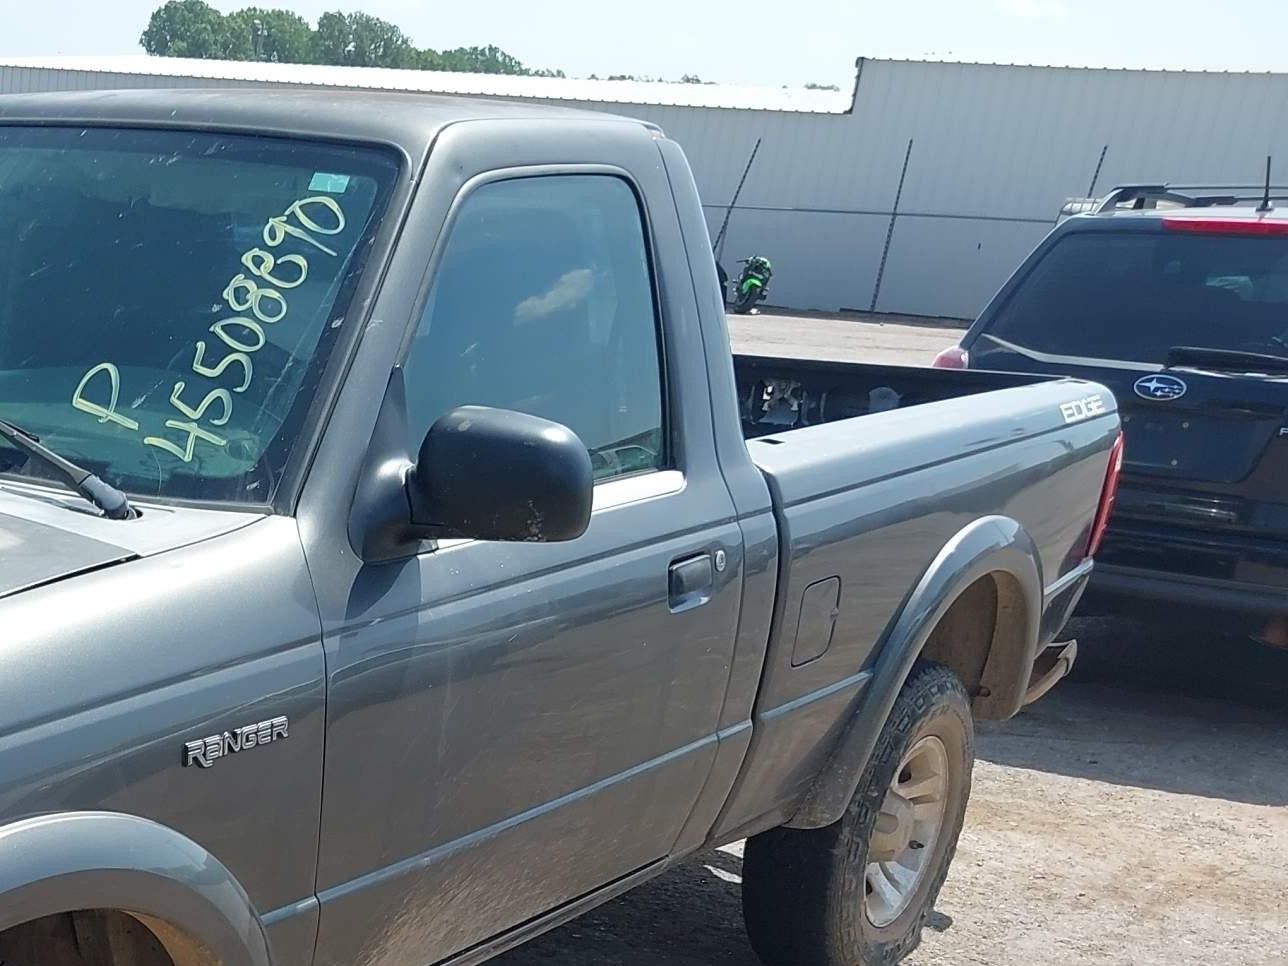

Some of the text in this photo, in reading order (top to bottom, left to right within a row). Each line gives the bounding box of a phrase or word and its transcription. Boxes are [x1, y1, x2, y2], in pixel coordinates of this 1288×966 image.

[143, 195, 346, 464] 45508890
[72, 362, 139, 431] P
[1059, 394, 1106, 424] EDGE
[182, 714, 290, 768] RANGER
